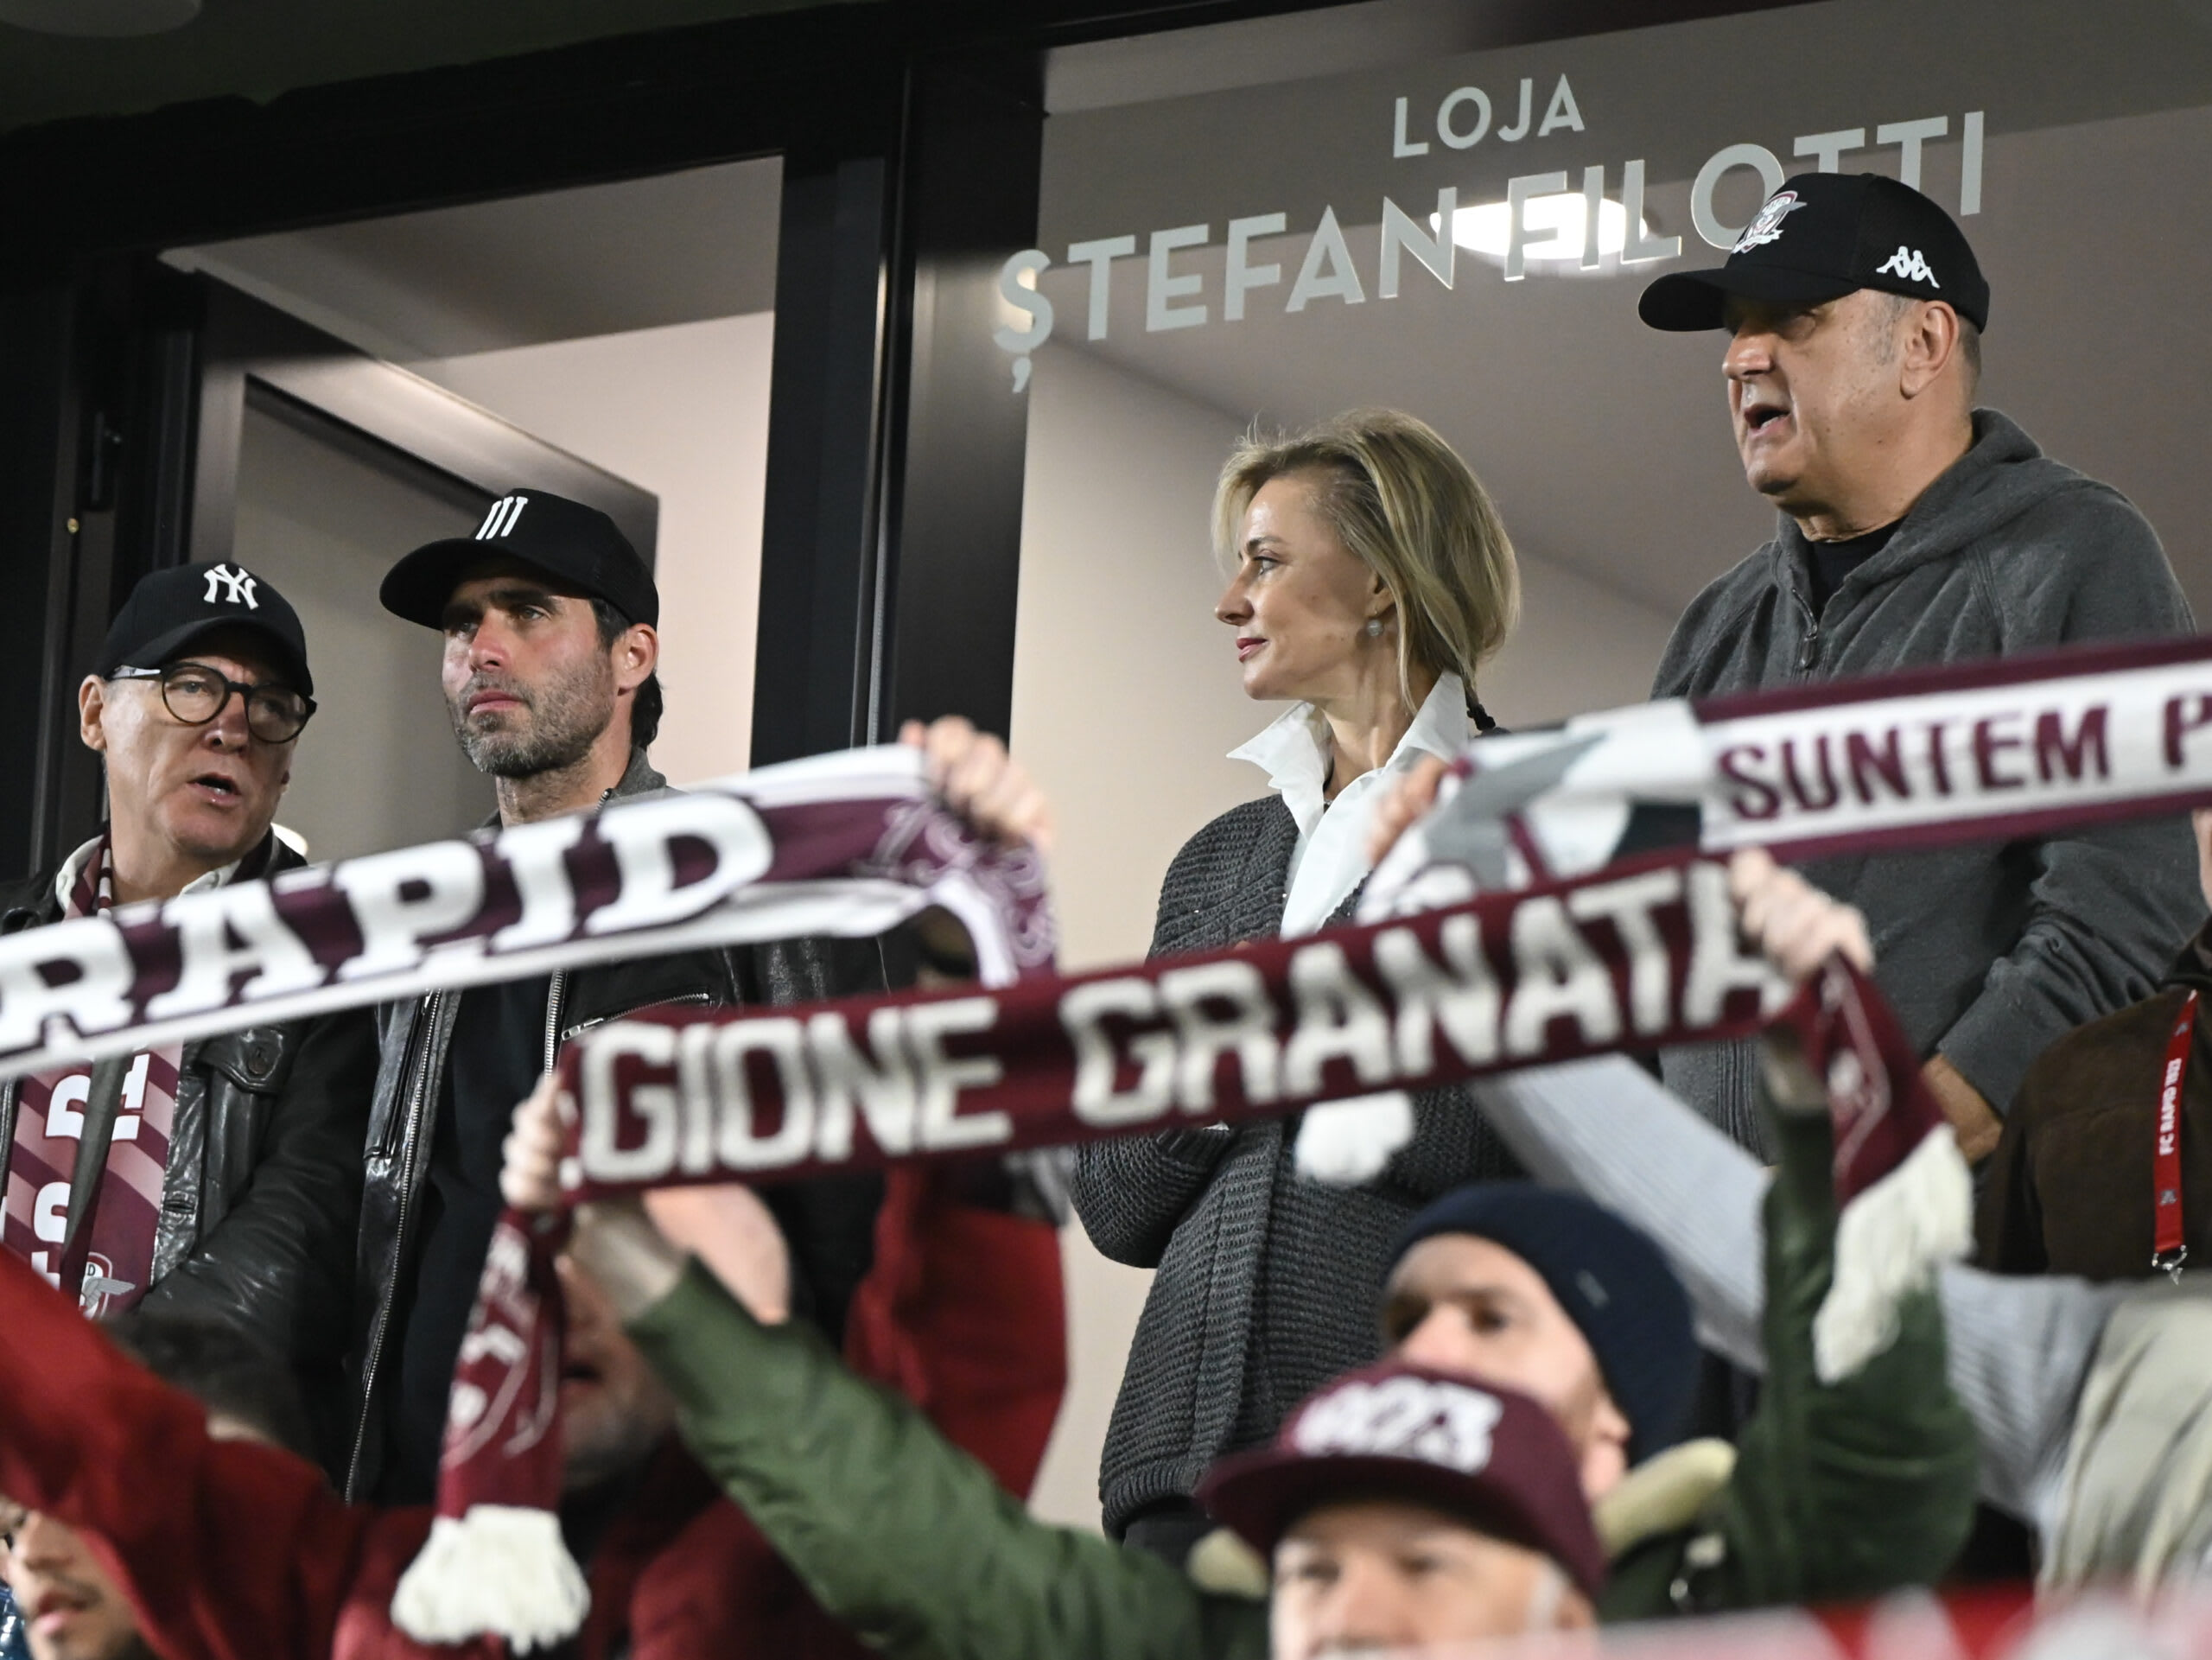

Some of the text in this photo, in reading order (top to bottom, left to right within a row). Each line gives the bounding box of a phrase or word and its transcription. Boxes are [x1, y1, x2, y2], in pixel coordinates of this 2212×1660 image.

[1393, 73, 1585, 159] LOJA
[1716, 703, 2110, 821] SUNTEM
[0, 792, 773, 1054] RAPID
[558, 860, 1794, 1191] GIONE GRANATA
